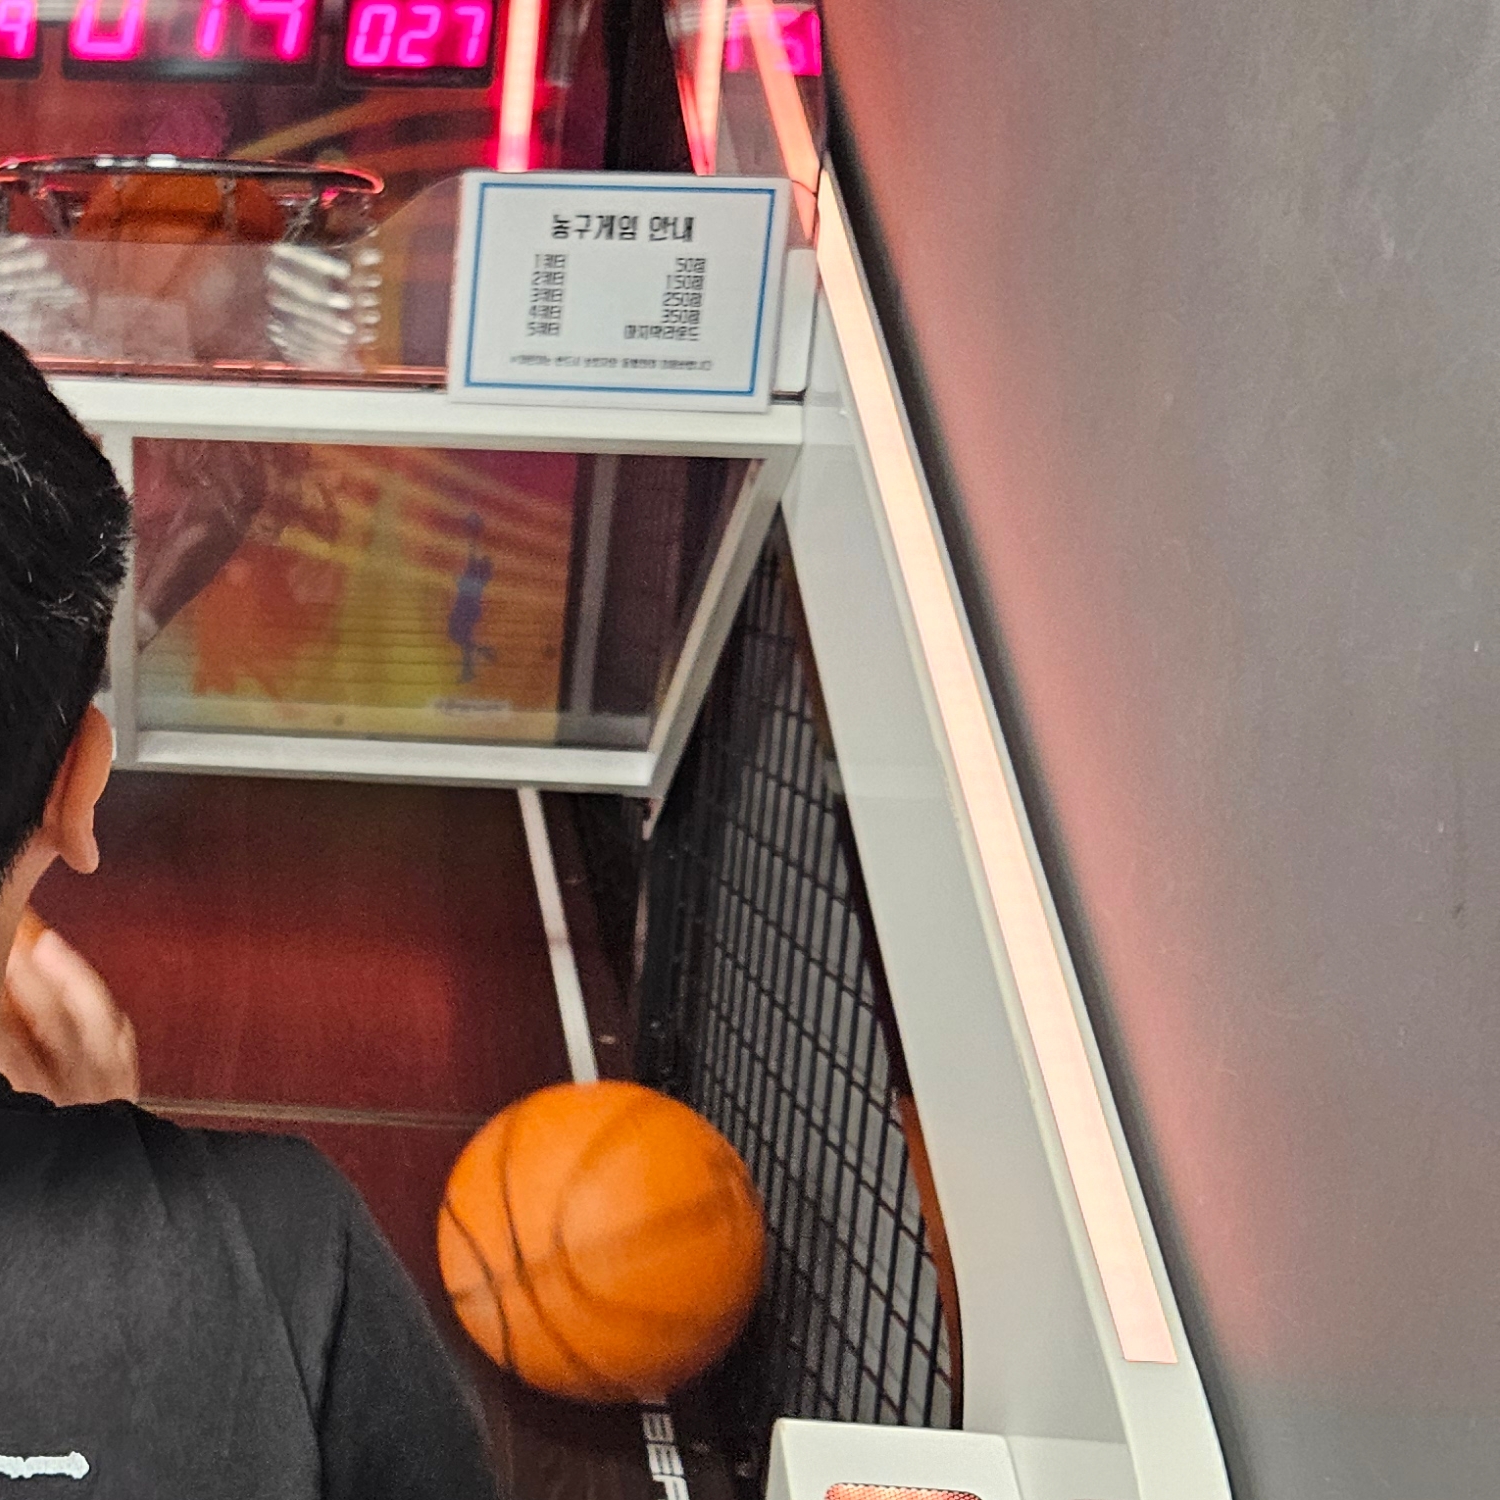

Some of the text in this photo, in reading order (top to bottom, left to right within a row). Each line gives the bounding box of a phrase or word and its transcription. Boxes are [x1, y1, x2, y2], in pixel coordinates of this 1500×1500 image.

[352, 4, 489, 64] 027
[551, 213, 695, 243] 농구게임 안내
